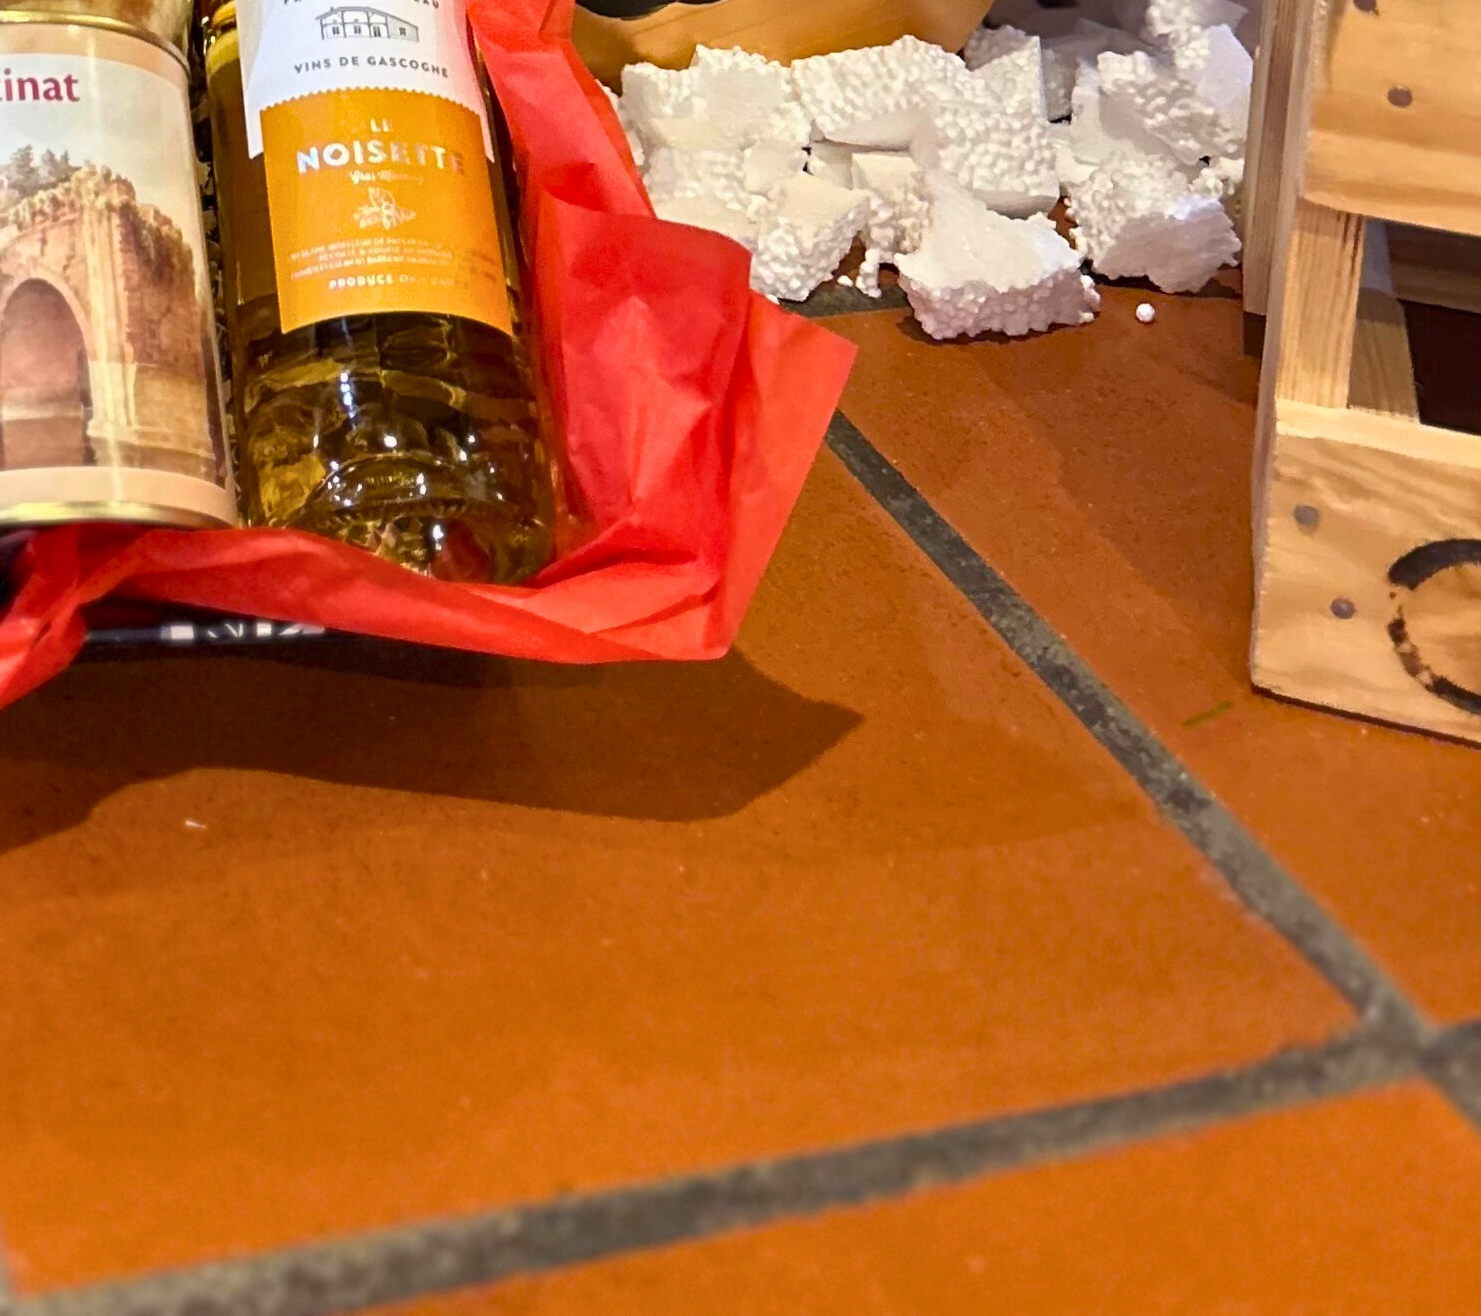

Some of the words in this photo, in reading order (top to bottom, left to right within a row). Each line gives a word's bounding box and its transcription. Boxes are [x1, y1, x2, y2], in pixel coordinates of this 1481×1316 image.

[294, 57, 331, 74] VINS
[339, 56, 360, 67] DE
[367, 56, 450, 78] GASCOGNE
